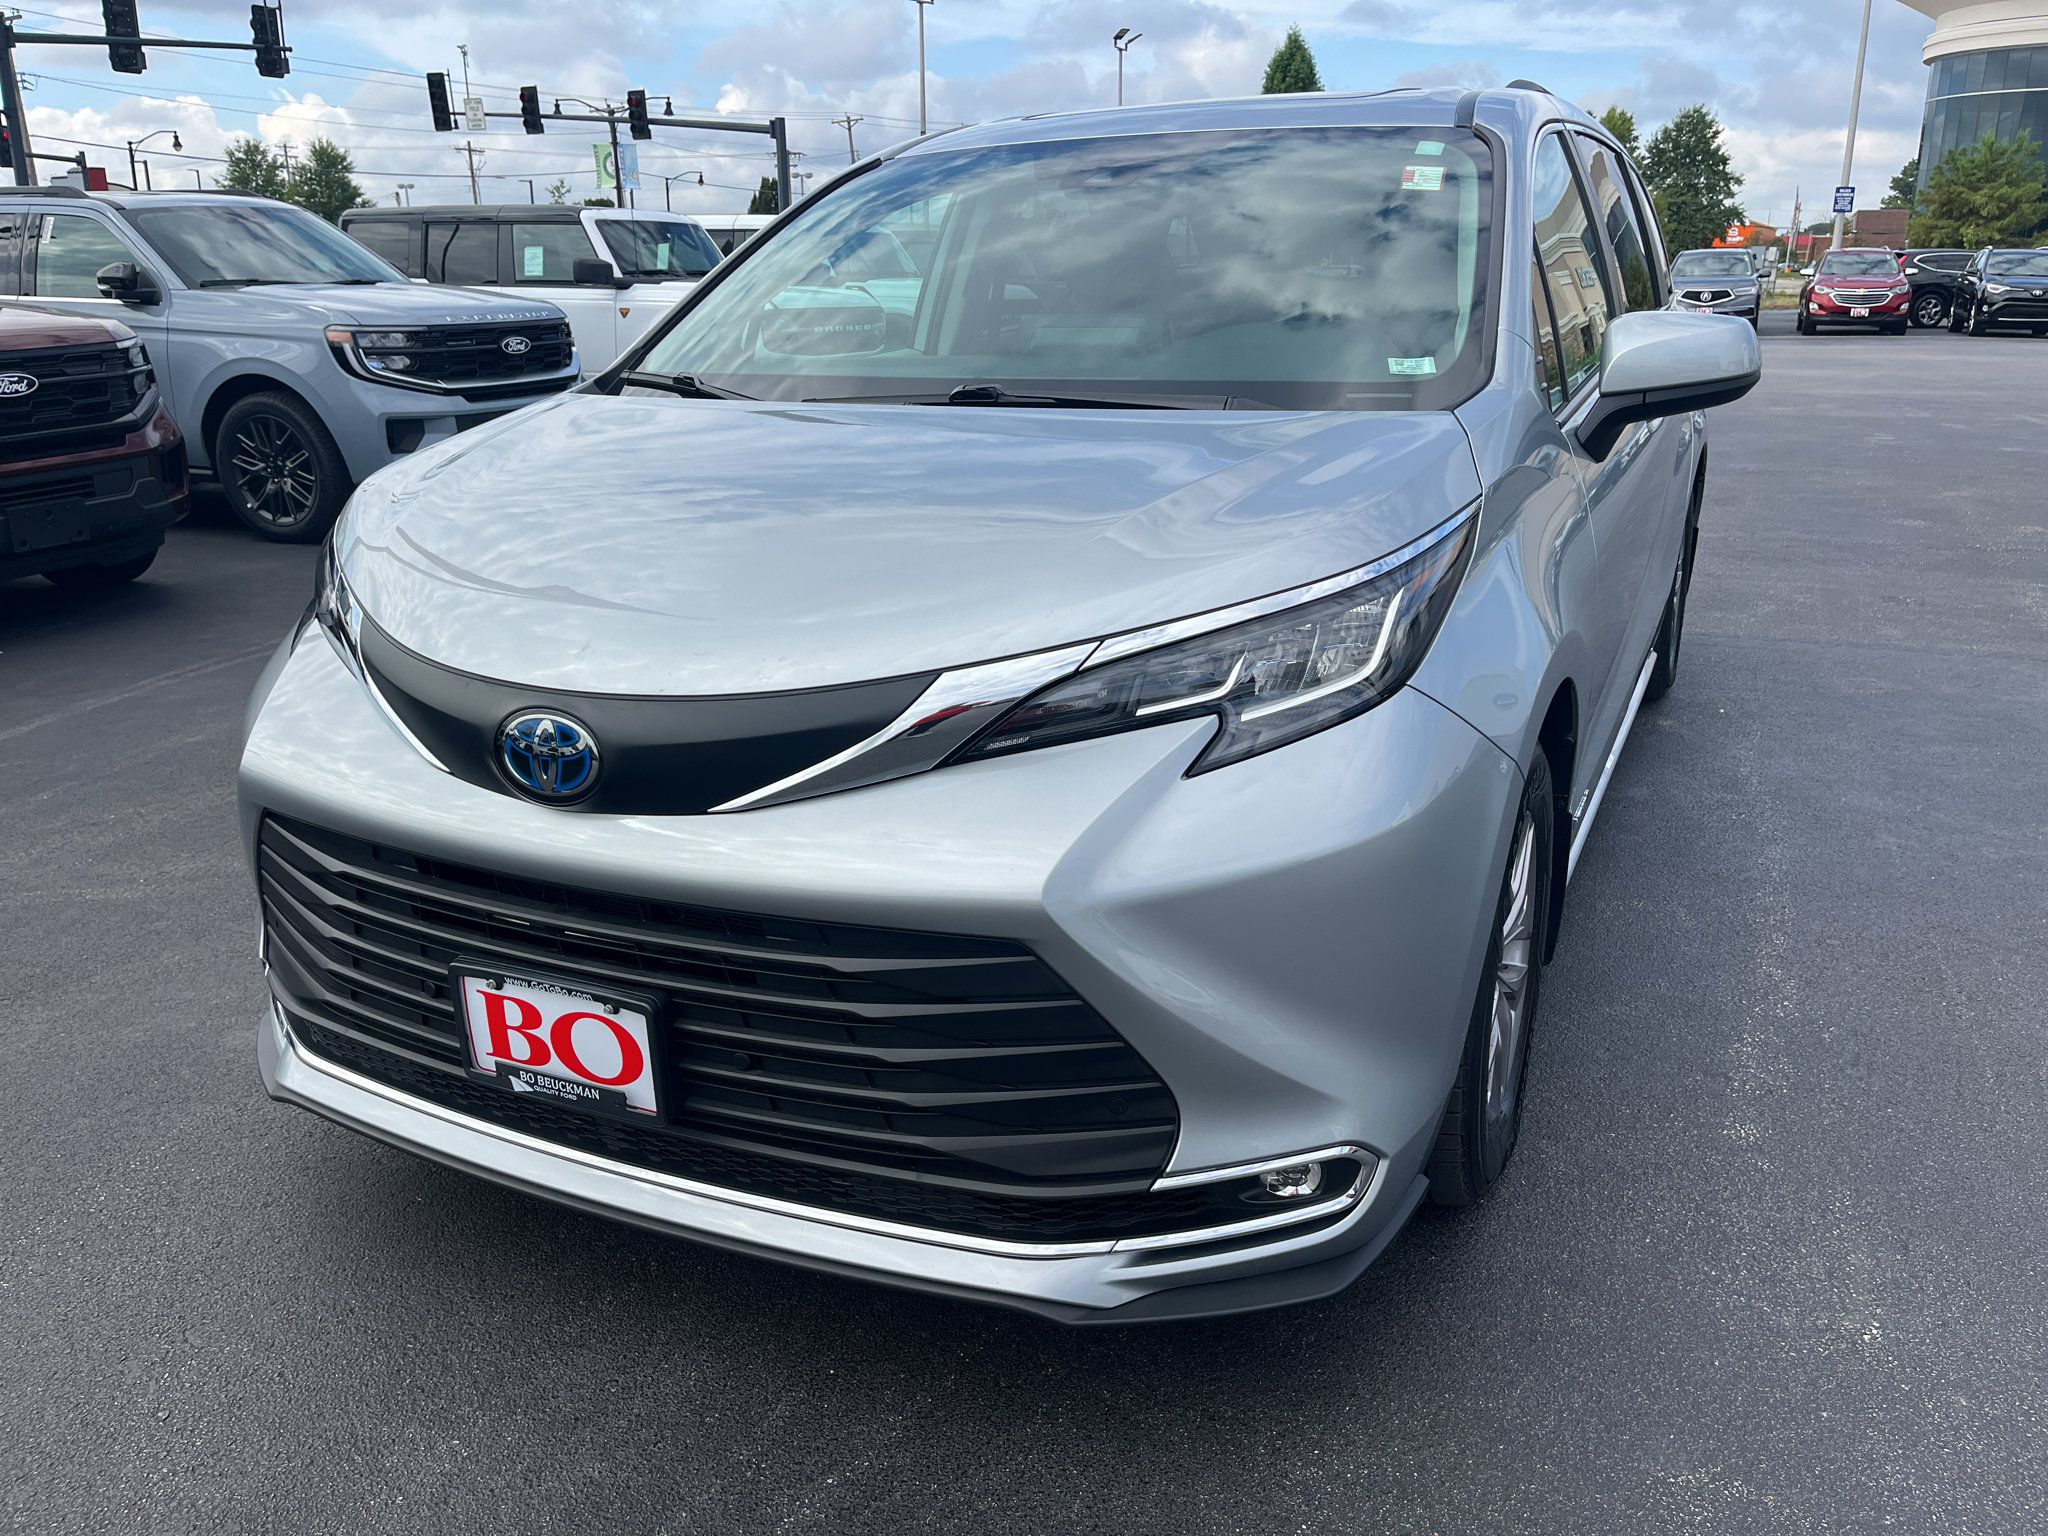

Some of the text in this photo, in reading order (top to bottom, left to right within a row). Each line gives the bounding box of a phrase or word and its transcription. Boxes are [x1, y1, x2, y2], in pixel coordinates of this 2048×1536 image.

[504, 977, 593, 1002] www.GoToBo.com
[476, 989, 644, 1086] BO
[519, 1070, 600, 1100] BO BEUCKMAN
[533, 1085, 578, 1101] QUALITY FORD
